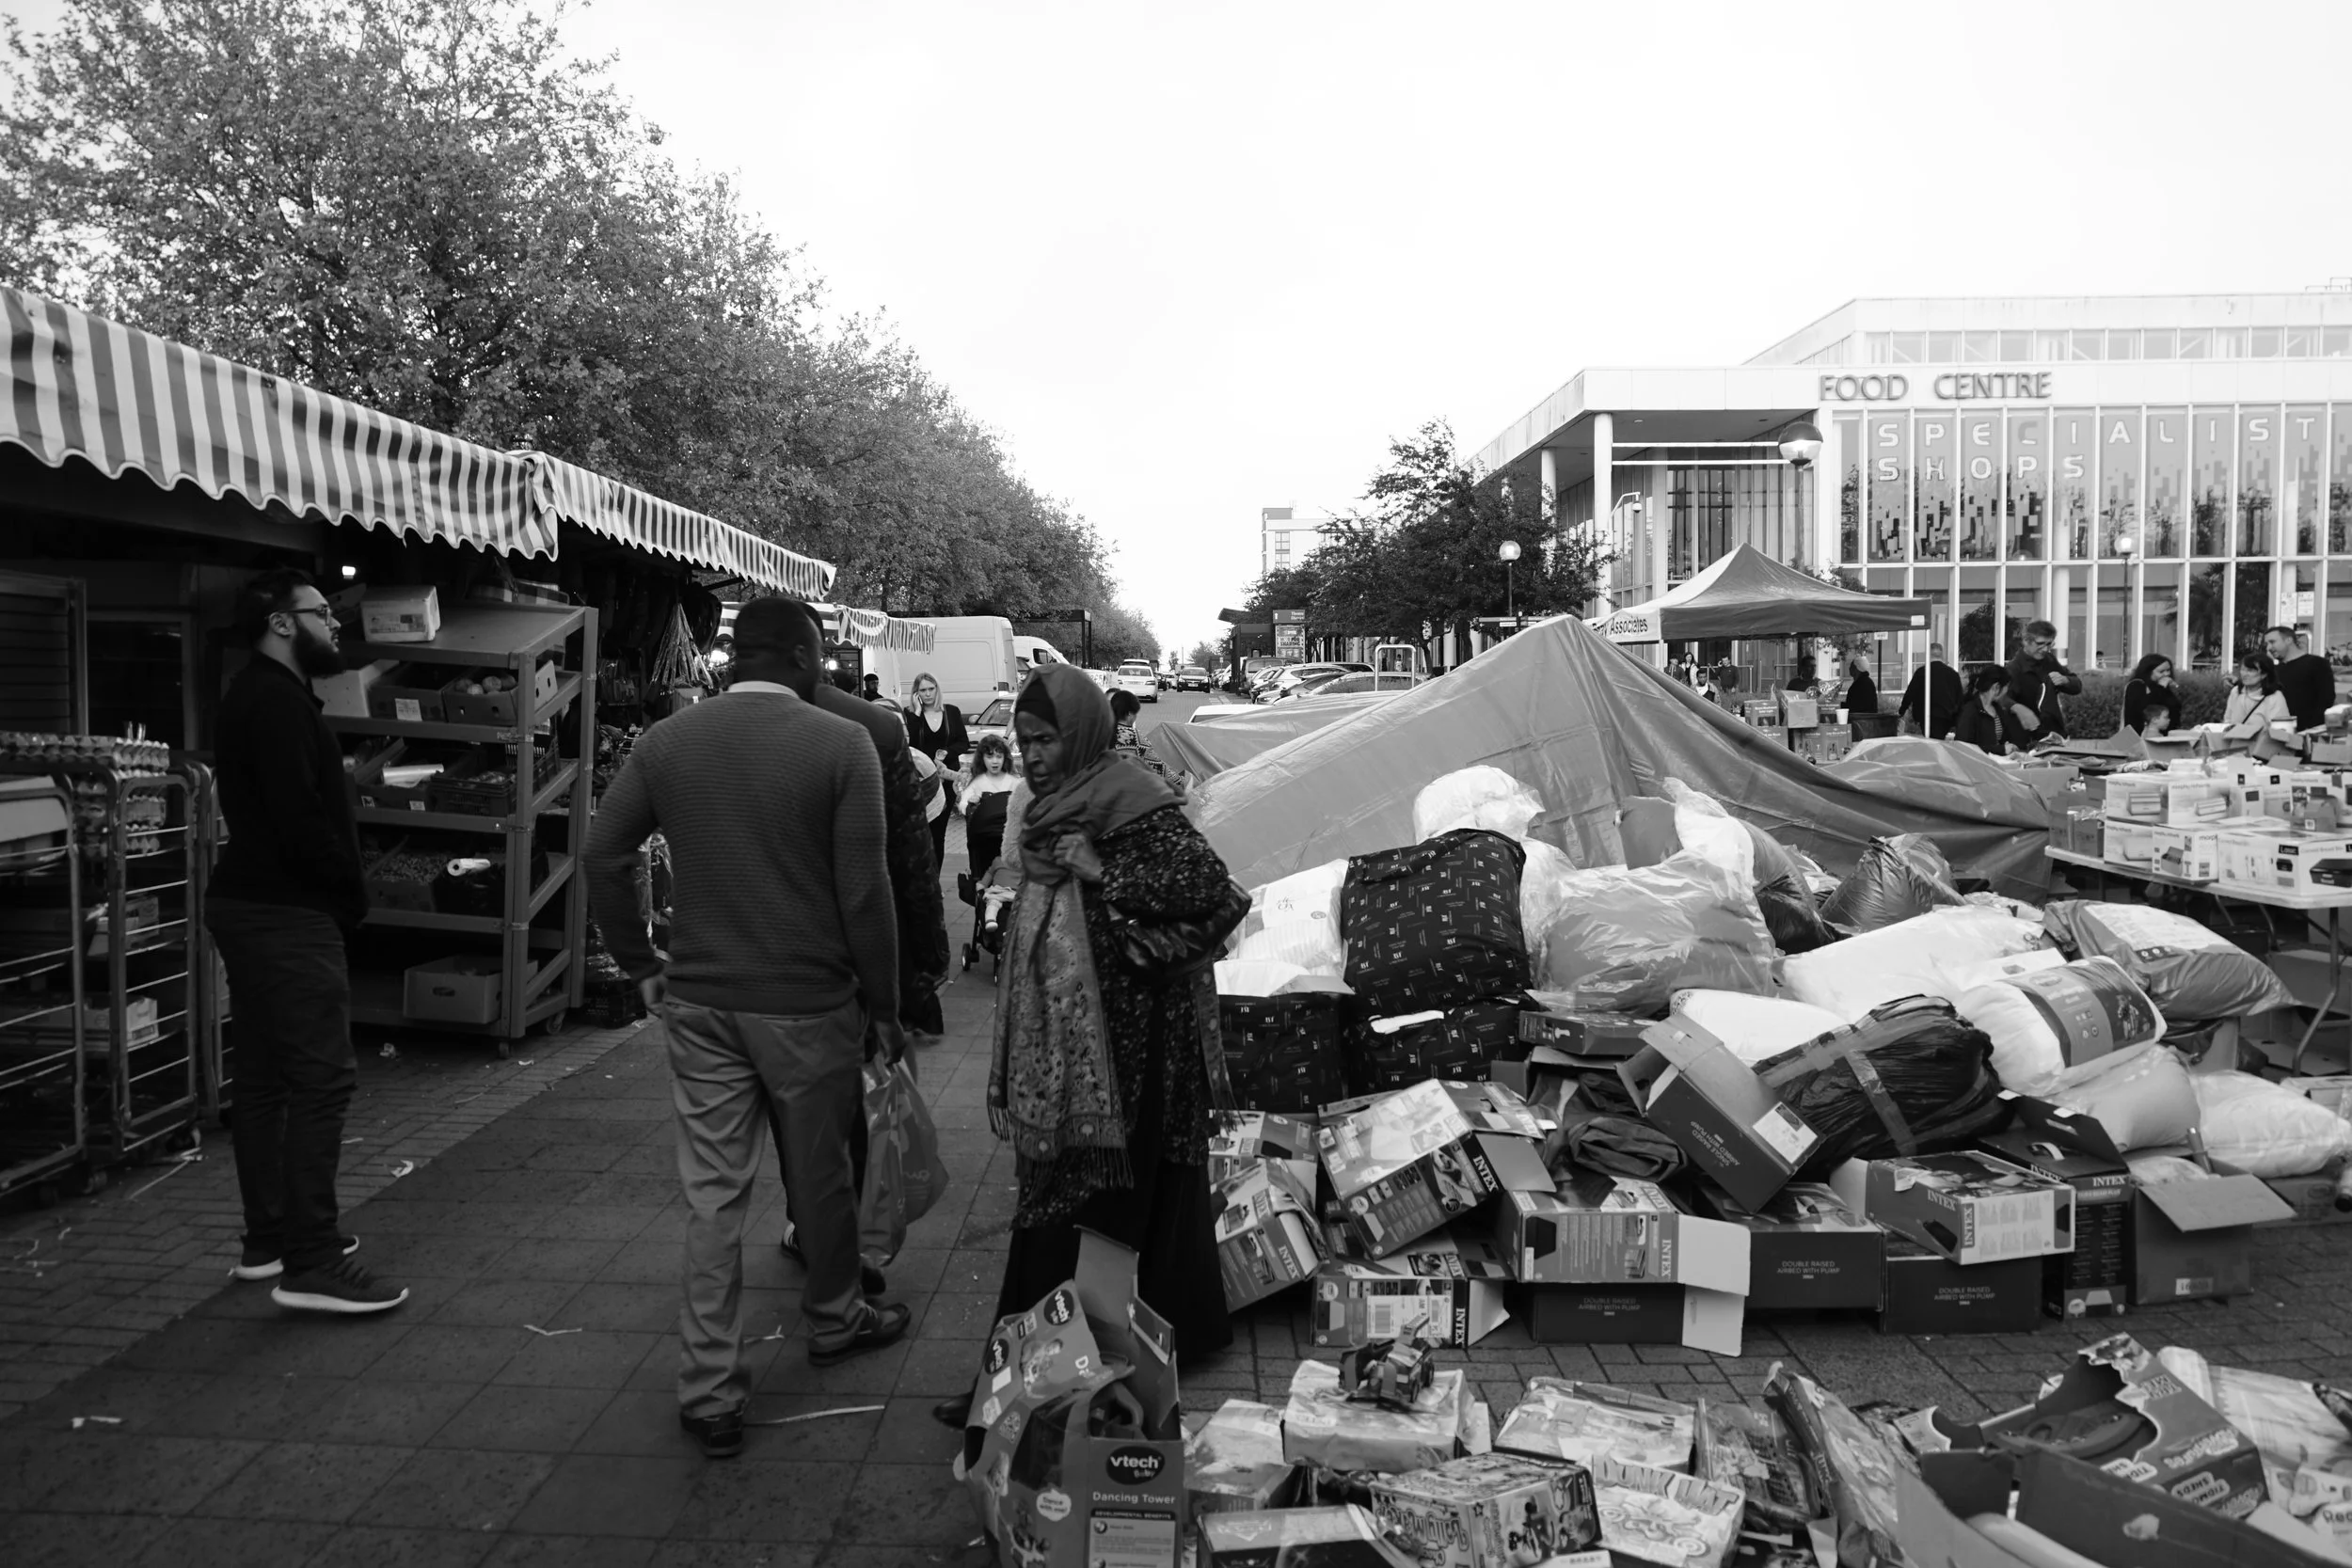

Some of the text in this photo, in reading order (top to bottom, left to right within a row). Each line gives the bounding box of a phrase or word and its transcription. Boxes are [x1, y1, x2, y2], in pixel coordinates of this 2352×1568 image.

[1820, 372, 2052, 401] FOOD CENTRE
[1878, 417, 2315, 448] SPECIALIST
[1878, 454, 2084, 482] SHOPS
[1611, 618, 1648, 634] Associates
[1473, 1155, 1499, 1192] INTEX
[2092, 1176, 2126, 1187] INTEX
[1928, 1190, 1957, 1212] INTEX
[1964, 1207, 1974, 1246] INTEX
[1278, 1245, 1300, 1279] INTEX
[1661, 1239, 1672, 1278] INTEX
[1455, 1307, 1467, 1345] INTEX
[1110, 1455, 1159, 1469] vtech
[1092, 1491, 1176, 1504] Dancing Tower
[2176, 1477, 2210, 1497] SHEDS
[2192, 1483, 2226, 1505] TIDMO
